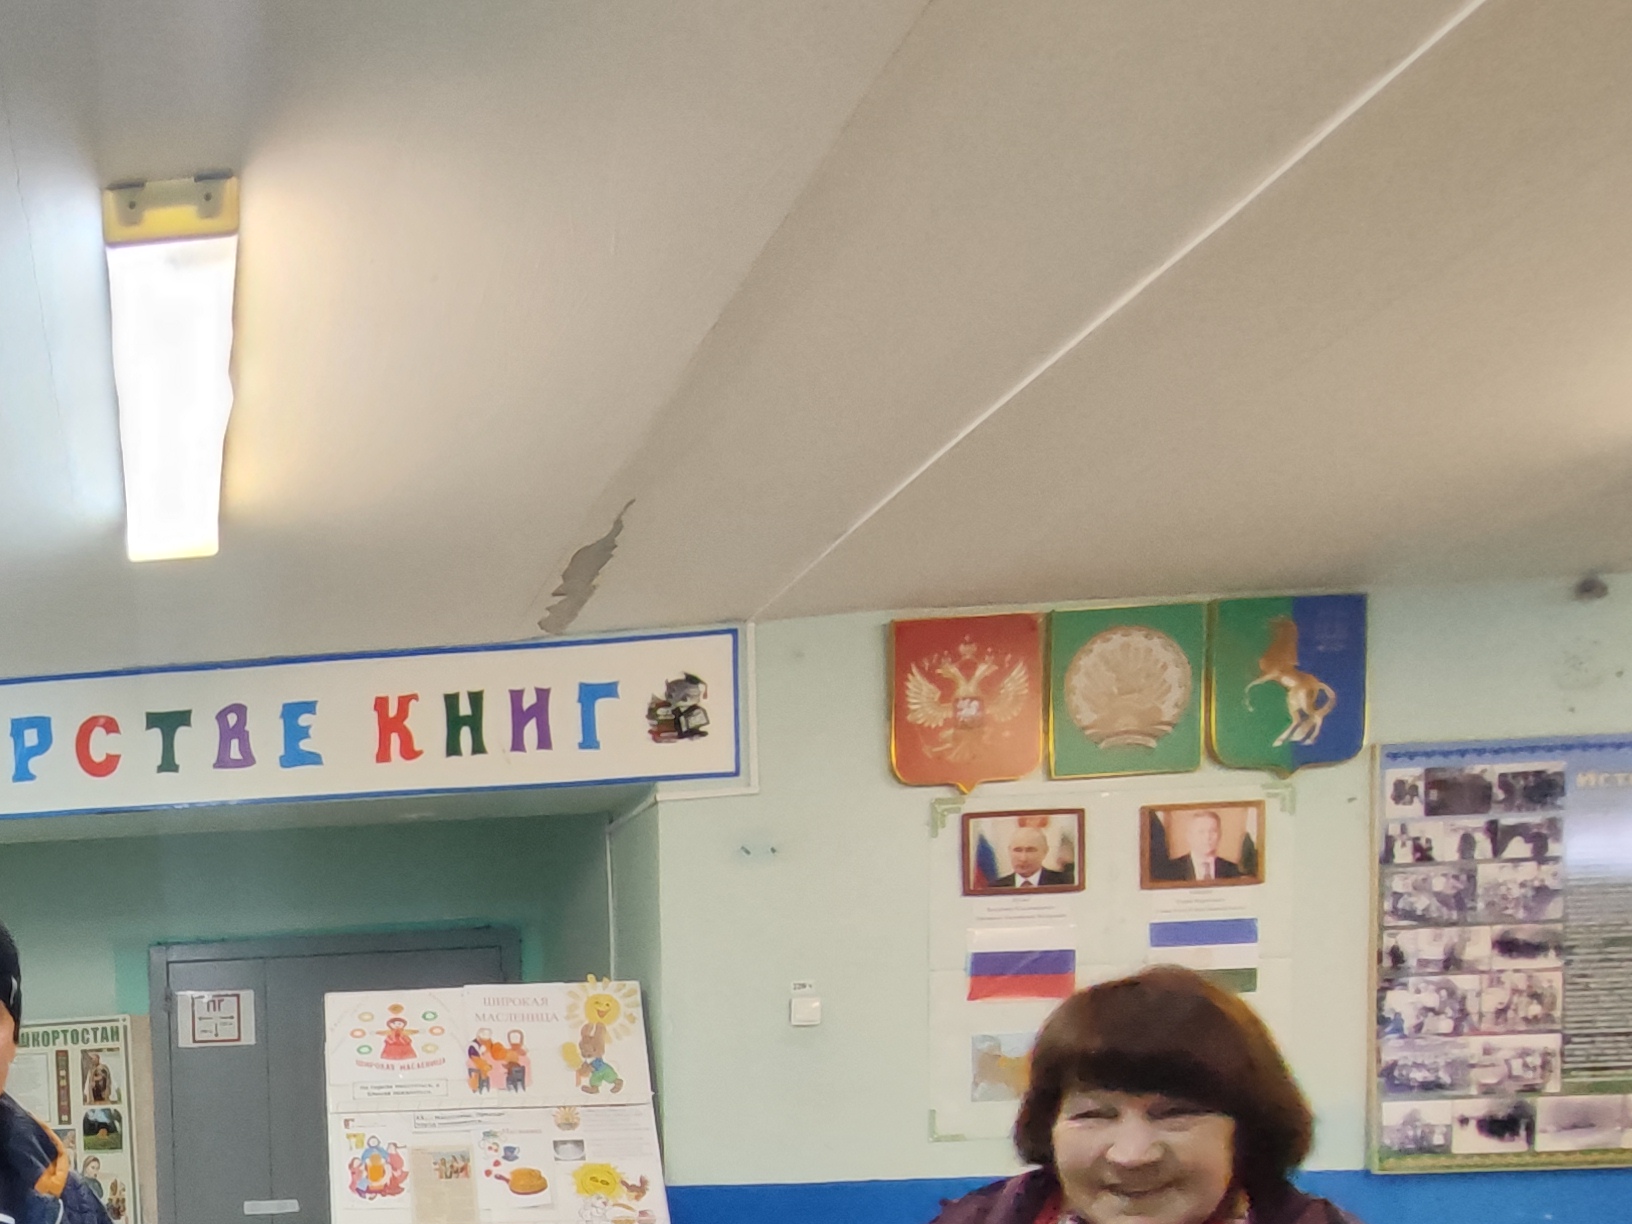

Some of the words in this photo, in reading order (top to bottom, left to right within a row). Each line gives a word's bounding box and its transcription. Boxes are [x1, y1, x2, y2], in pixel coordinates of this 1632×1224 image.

[373, 680, 620, 764] КНИГ
[483, 997, 549, 1007] ШИРОКАЯ
[475, 1012, 559, 1023] МАСЛЕНИЦА
[18, 1025, 120, 1048] ШКОРТОСТАН
